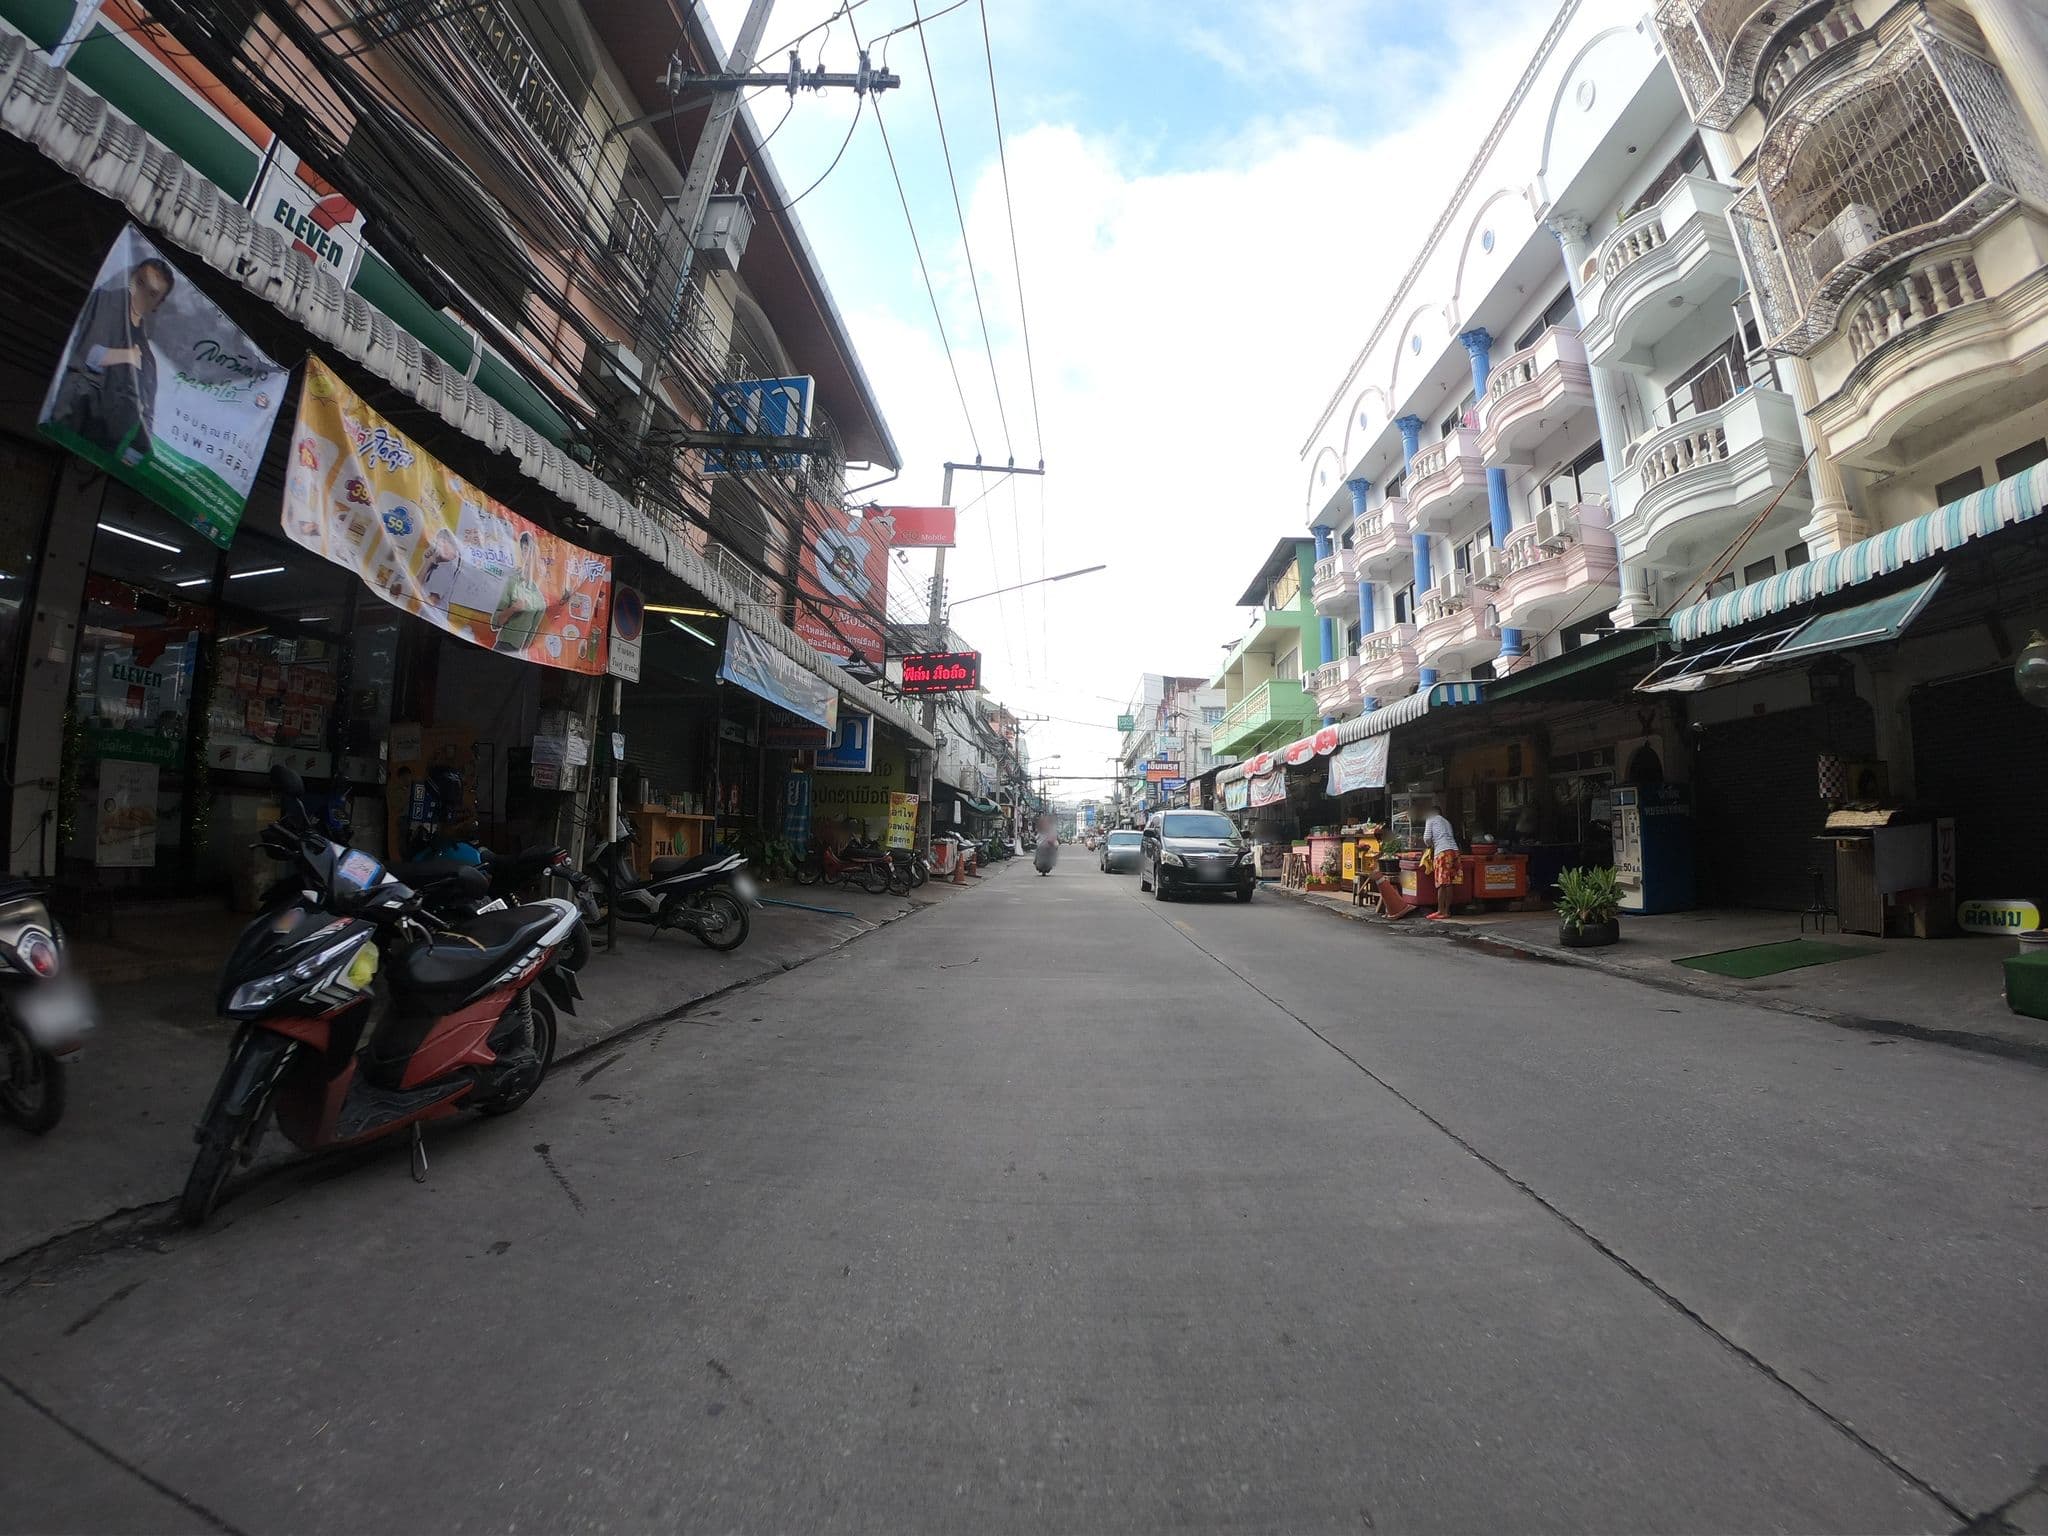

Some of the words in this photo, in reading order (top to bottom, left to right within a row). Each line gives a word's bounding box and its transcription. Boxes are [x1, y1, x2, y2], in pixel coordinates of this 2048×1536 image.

[932, 663, 967, 680] มือถือ
[788, 780, 808, 807] ยา
[1964, 903, 2021, 928] ตัดผม
